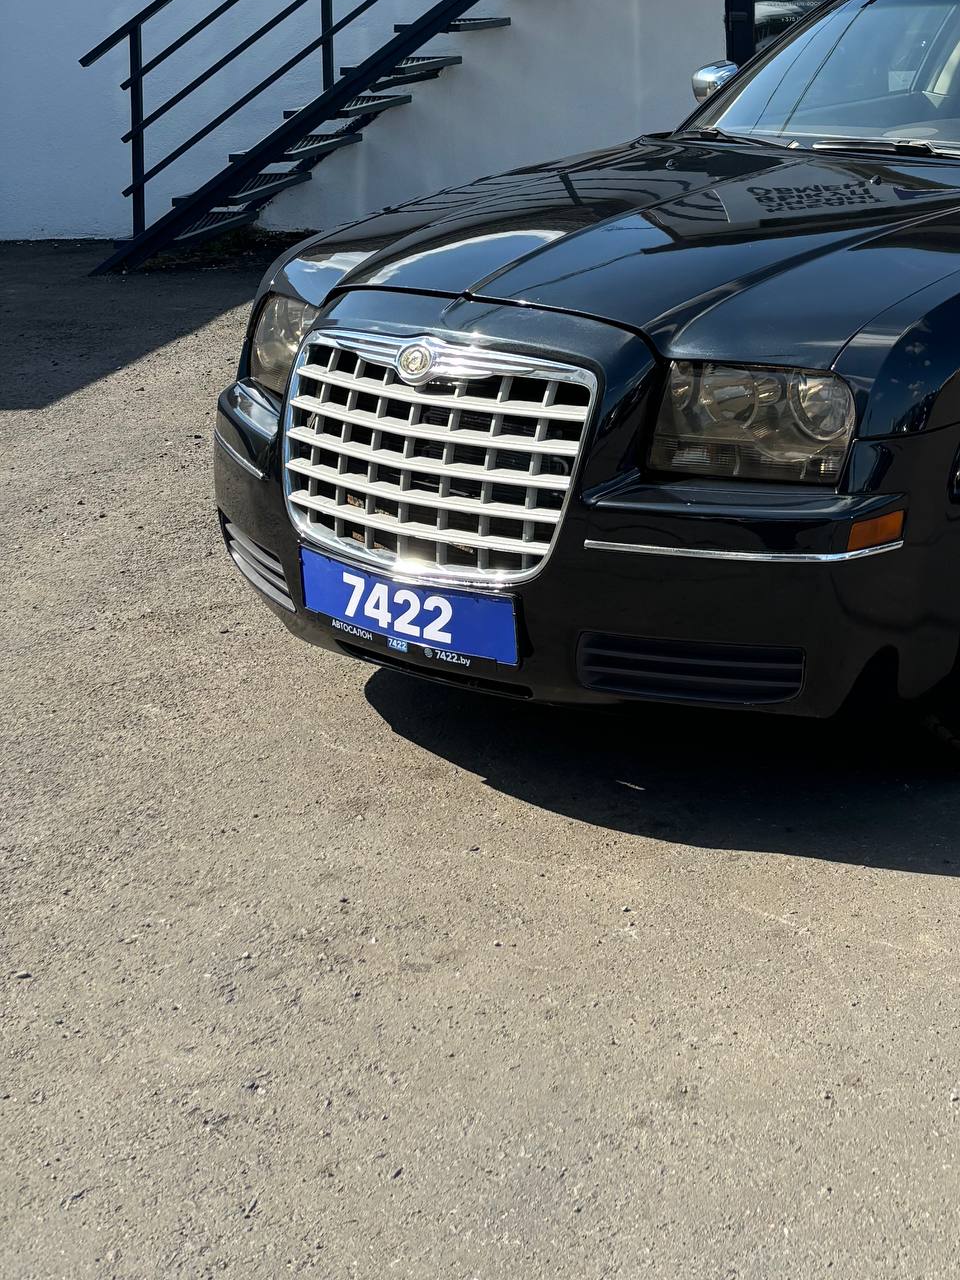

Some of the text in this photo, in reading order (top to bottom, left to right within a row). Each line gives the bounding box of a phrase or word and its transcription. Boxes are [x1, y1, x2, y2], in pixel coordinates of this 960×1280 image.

[342, 571, 453, 644] 7422
[331, 619, 471, 666] АВТОСАЛОН 7422 7422.by
